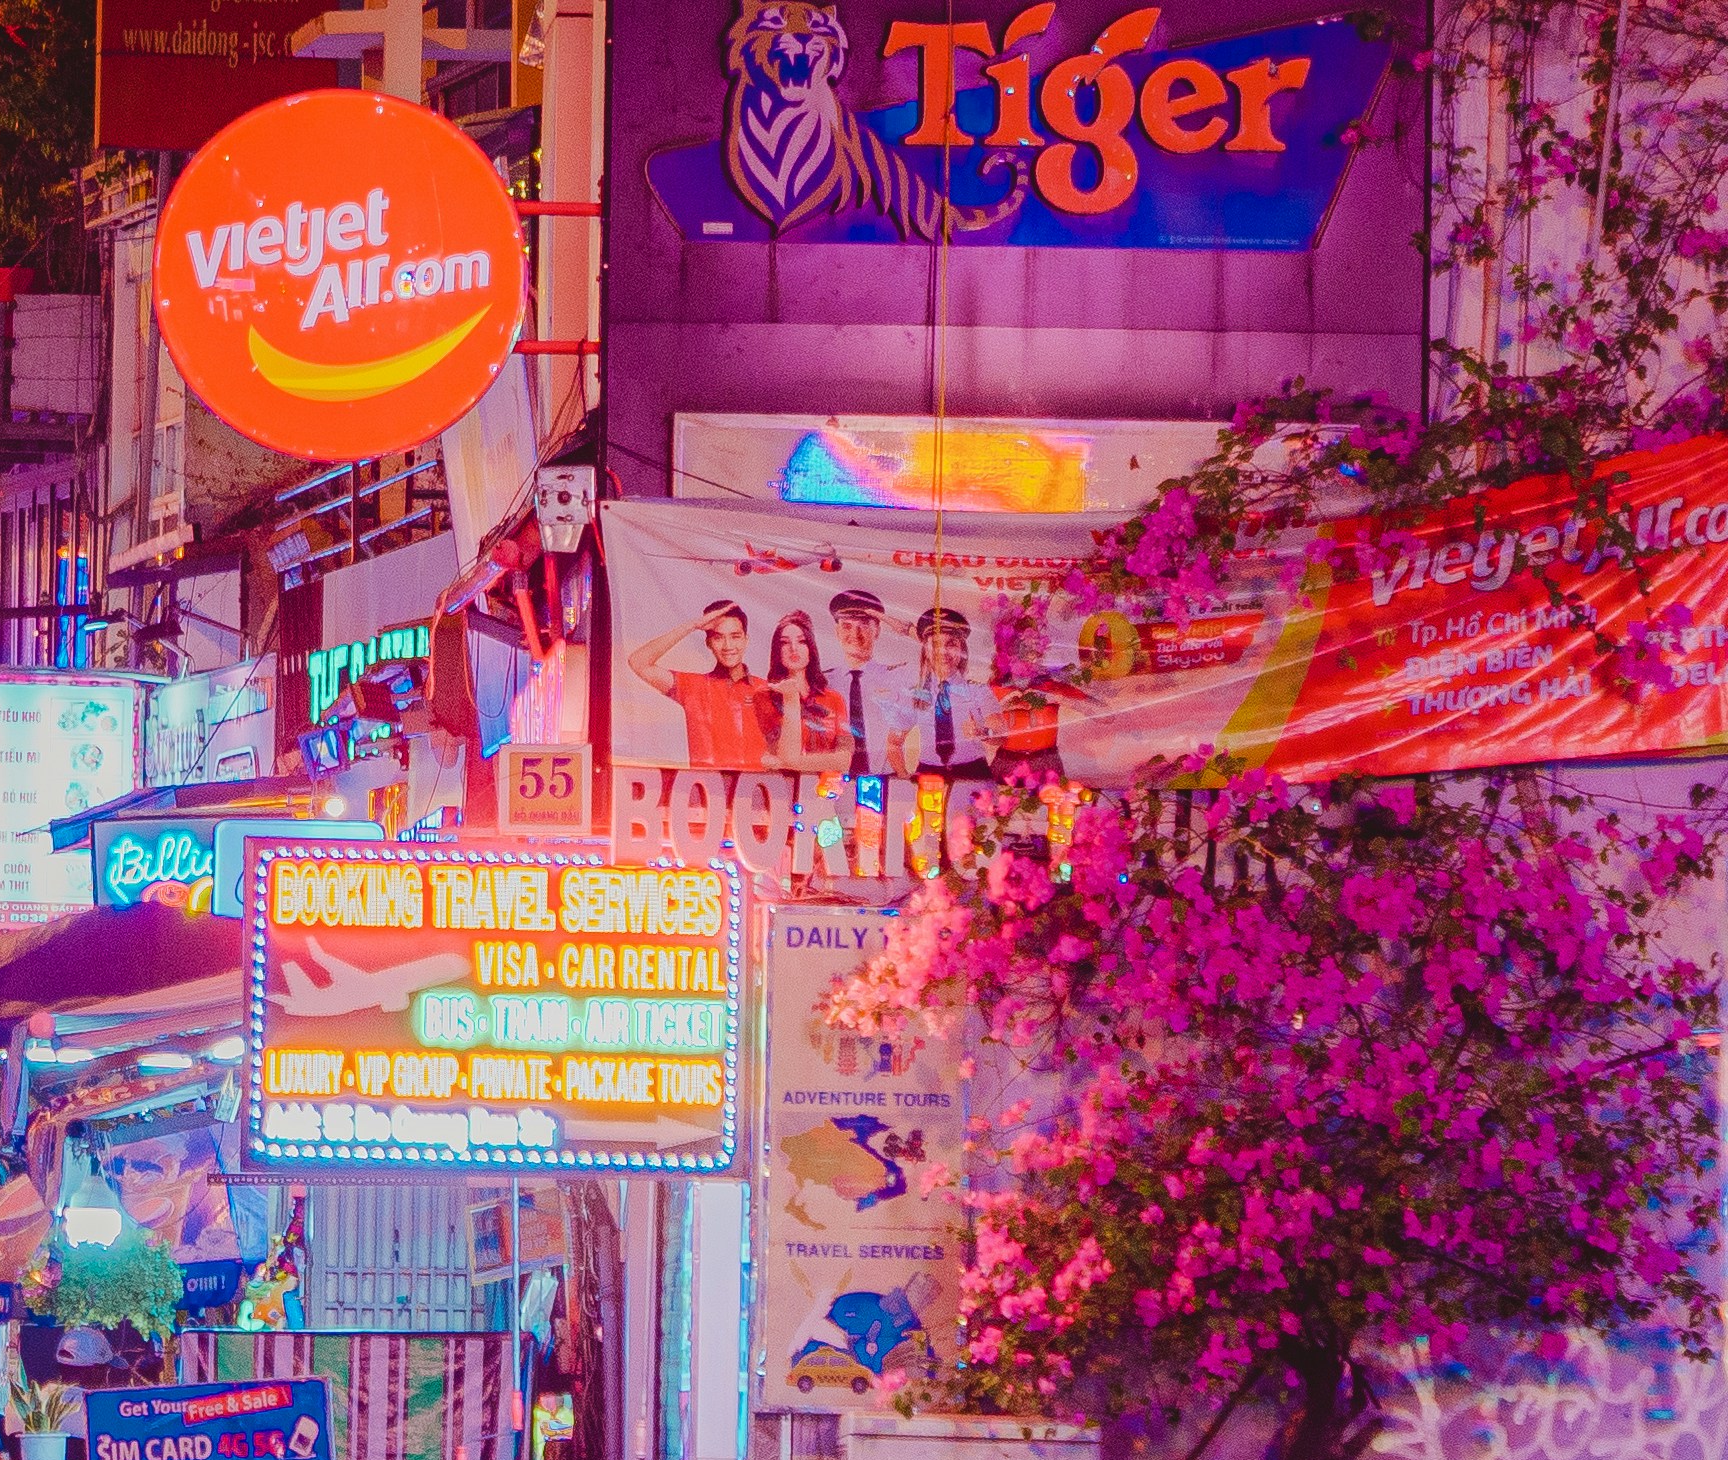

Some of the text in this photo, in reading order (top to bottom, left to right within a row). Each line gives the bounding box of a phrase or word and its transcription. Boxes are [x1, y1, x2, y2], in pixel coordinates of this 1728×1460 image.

[883, 2, 1311, 215] Tiger
[520, 757, 574, 800] 55
[274, 866, 722, 936] BOOKING TRAVEL SERVICES
[787, 926, 868, 950] DAILY
[476, 943, 725, 992] VISA CAR RENTAL
[423, 997, 724, 1047] BUS TRAIN AIR TICKET
[269, 1053, 722, 1104] LUXURY VIP GROUP PRIVATE PACKAGE TOURS
[783, 1091, 951, 1110] ADVENTURE TOURS
[785, 1242, 945, 1262] TRAVEL SERVICES
[119, 1391, 278, 1420] Get Your Free & Sale
[218, 1433, 249, 1458] 4G
